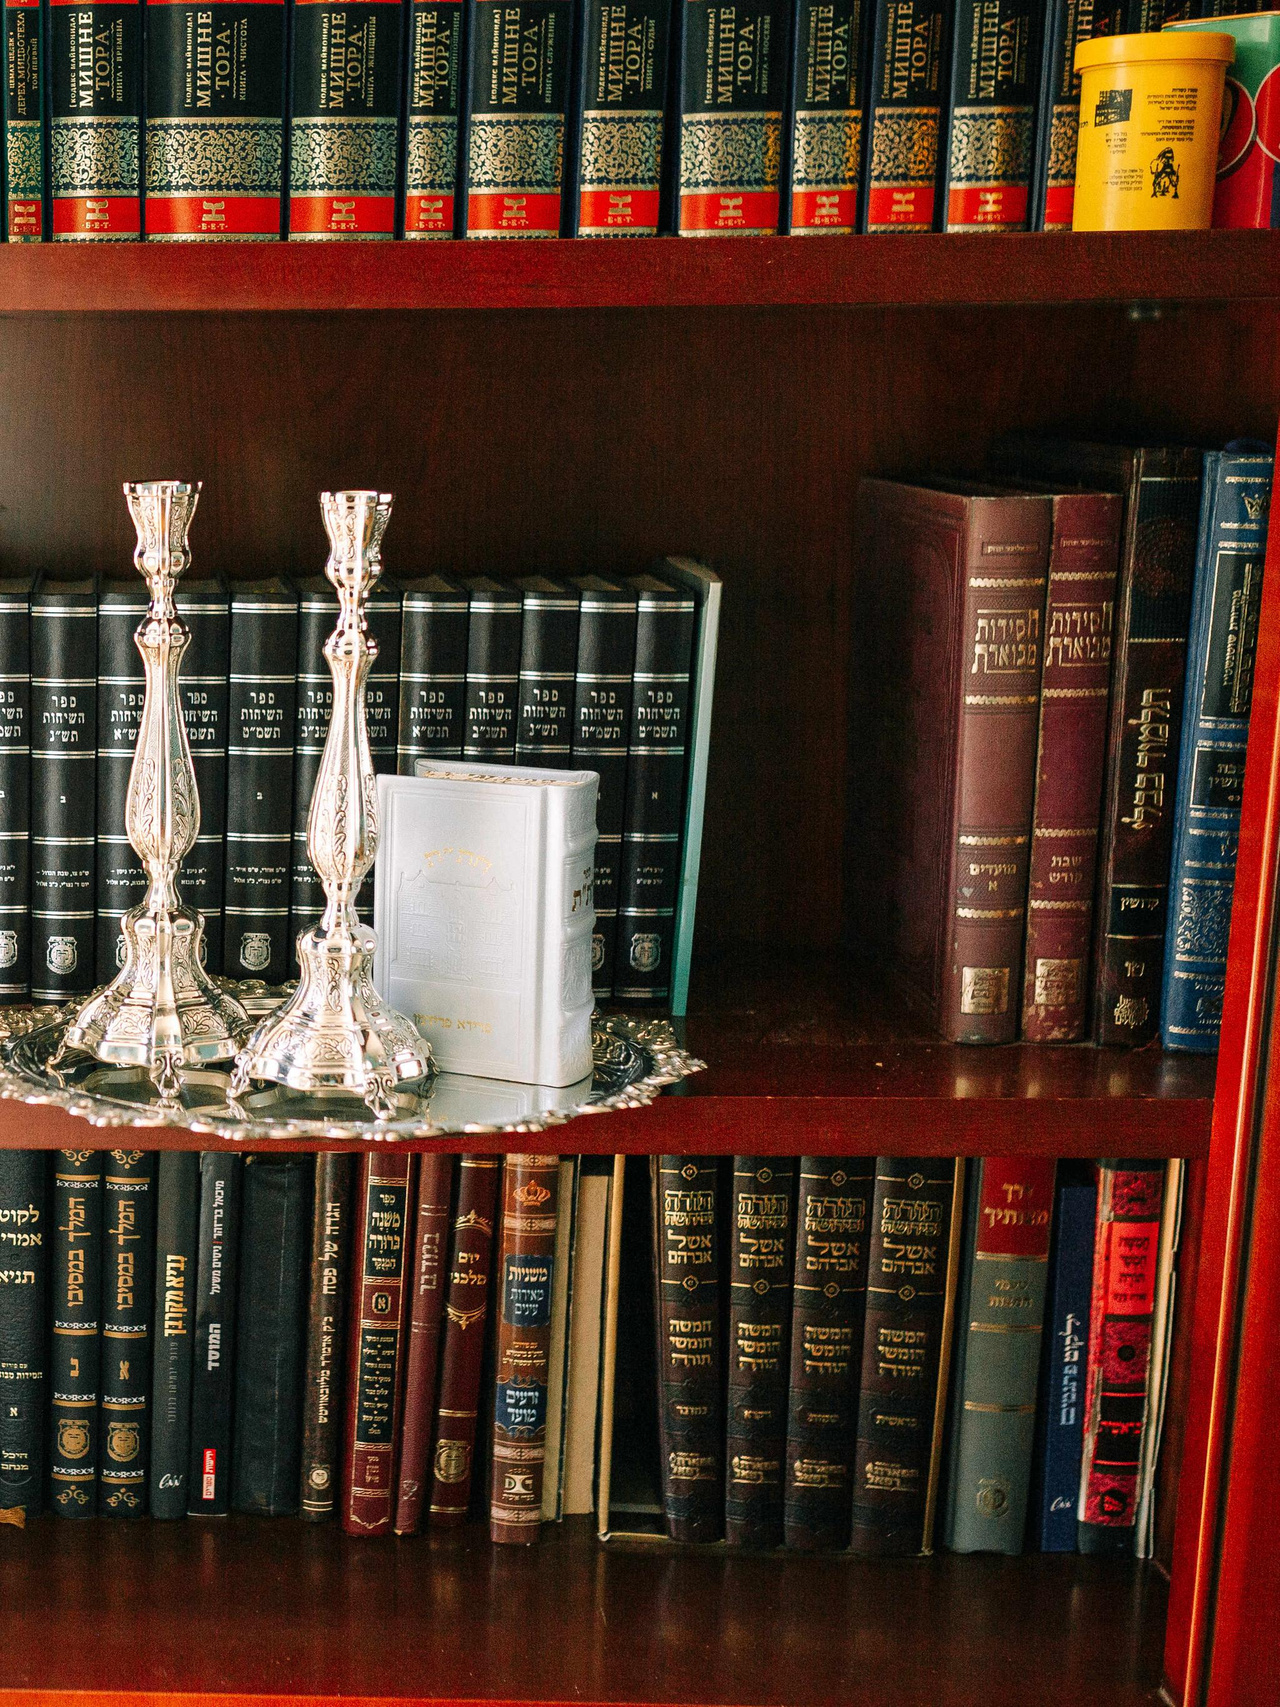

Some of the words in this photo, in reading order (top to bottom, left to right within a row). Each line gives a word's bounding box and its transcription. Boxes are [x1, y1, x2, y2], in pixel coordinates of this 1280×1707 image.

[79, 12, 93, 107] МИШНЕ
[95, 30, 110, 91] ТОРА
[197, 12, 211, 107] МИШНЕ
[216, 30, 230, 90] ТОРА
[329, 13, 346, 108] МИШНЕ
[346, 31, 363, 93] ТОРА
[418, 12, 438, 107] МИШНЕ
[434, 28, 451, 89] ТОРА
[502, 8, 520, 104] МИШНЕ
[522, 26, 538, 86] ТОРА
[608, 6, 627, 101] МИШНЕ
[625, 24, 643, 87] ТОРА
[718, 7, 735, 103] МИШНЕ
[738, 24, 754, 85] ТОРА
[976, 610, 1038, 641] חסידות
[1050, 602, 1113, 634] חסידות
[971, 644, 1036, 674] מבוארת
[1045, 636, 1110, 667] מבוארת
[51, 696, 76, 709] ספר
[250, 692, 274, 704] ספר
[479, 691, 504, 703] ספר
[591, 691, 615, 703] ספר
[648, 691, 672, 703] ספר
[43, 712, 84, 724] השיחות
[241, 709, 282, 720] השיחות
[469, 708, 511, 720] השיחות
[581, 707, 623, 720] השיחות
[638, 707, 680, 719] השיחות
[1129, 689, 1171, 767] תלמוד
[1121, 774, 1164, 829] בבלי
[213, 1181, 224, 1207] מיכאל
[59, 1197, 91, 1242] המלך
[109, 1200, 140, 1245] המלך
[324, 1202, 340, 1237] הגדה
[318, 1241, 338, 1261] של
[667, 1229, 711, 1249] אשל
[740, 1232, 784, 1252] אשל
[212, 1246, 222, 1268] ניסים
[459, 1252, 480, 1263] יום
[668, 1250, 711, 1264] אברהם
[739, 1253, 784, 1267] אברהם
[67, 1250, 84, 1307] במסיבו
[117, 1253, 133, 1310] במסיבו
[210, 1270, 221, 1294] משעל
[321, 1268, 338, 1294] פסח
[508, 1266, 547, 1284] משניות
[510, 1288, 543, 1300] מאירות
[669, 1319, 710, 1334] חמשה
[208, 1324, 221, 1370] המוסד
[669, 1336, 711, 1350] חומשי
[671, 1353, 711, 1367] תורה
[506, 1389, 538, 1405] זרעים
[10, 1407, 17, 1416] א
[507, 1407, 536, 1423] מועד
[2, 1450, 27, 1458] היכל
